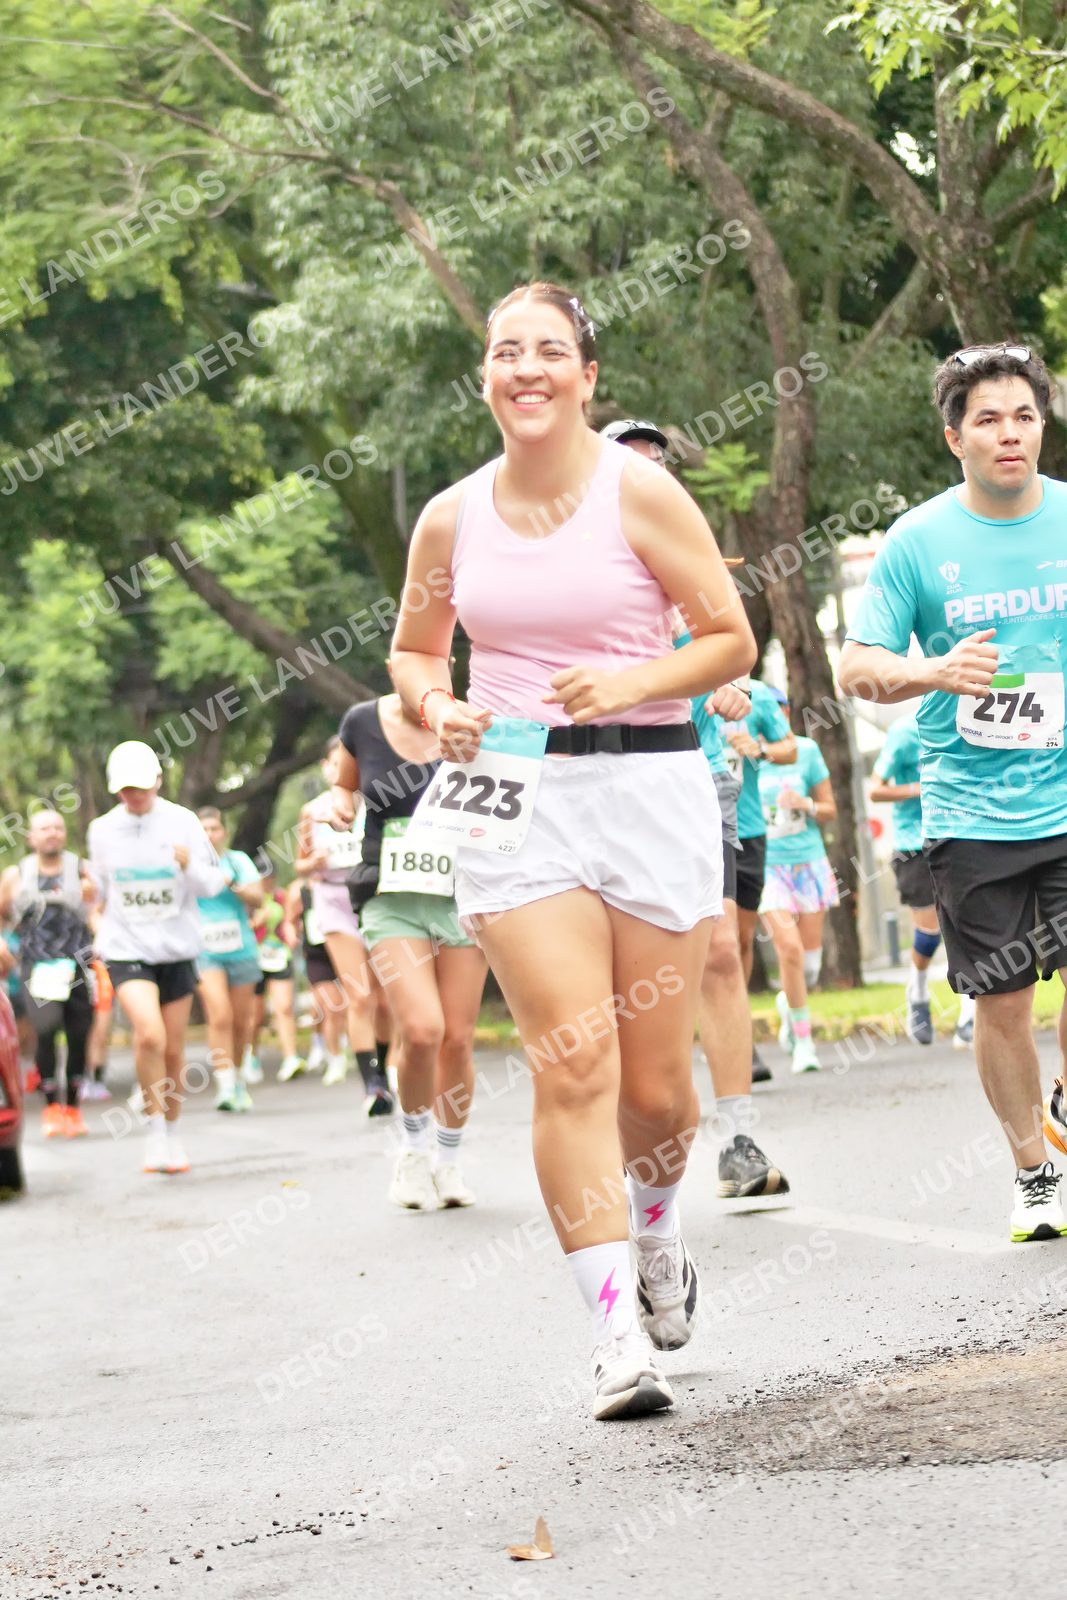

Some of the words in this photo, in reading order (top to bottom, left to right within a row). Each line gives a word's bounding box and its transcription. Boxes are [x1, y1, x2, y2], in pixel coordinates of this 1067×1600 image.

[1001, 613, 1055, 625] JUNTEADORES
[973, 692, 1044, 724] 274
[390, 851, 452, 875] 1880
[121, 889, 174, 906] 3645
